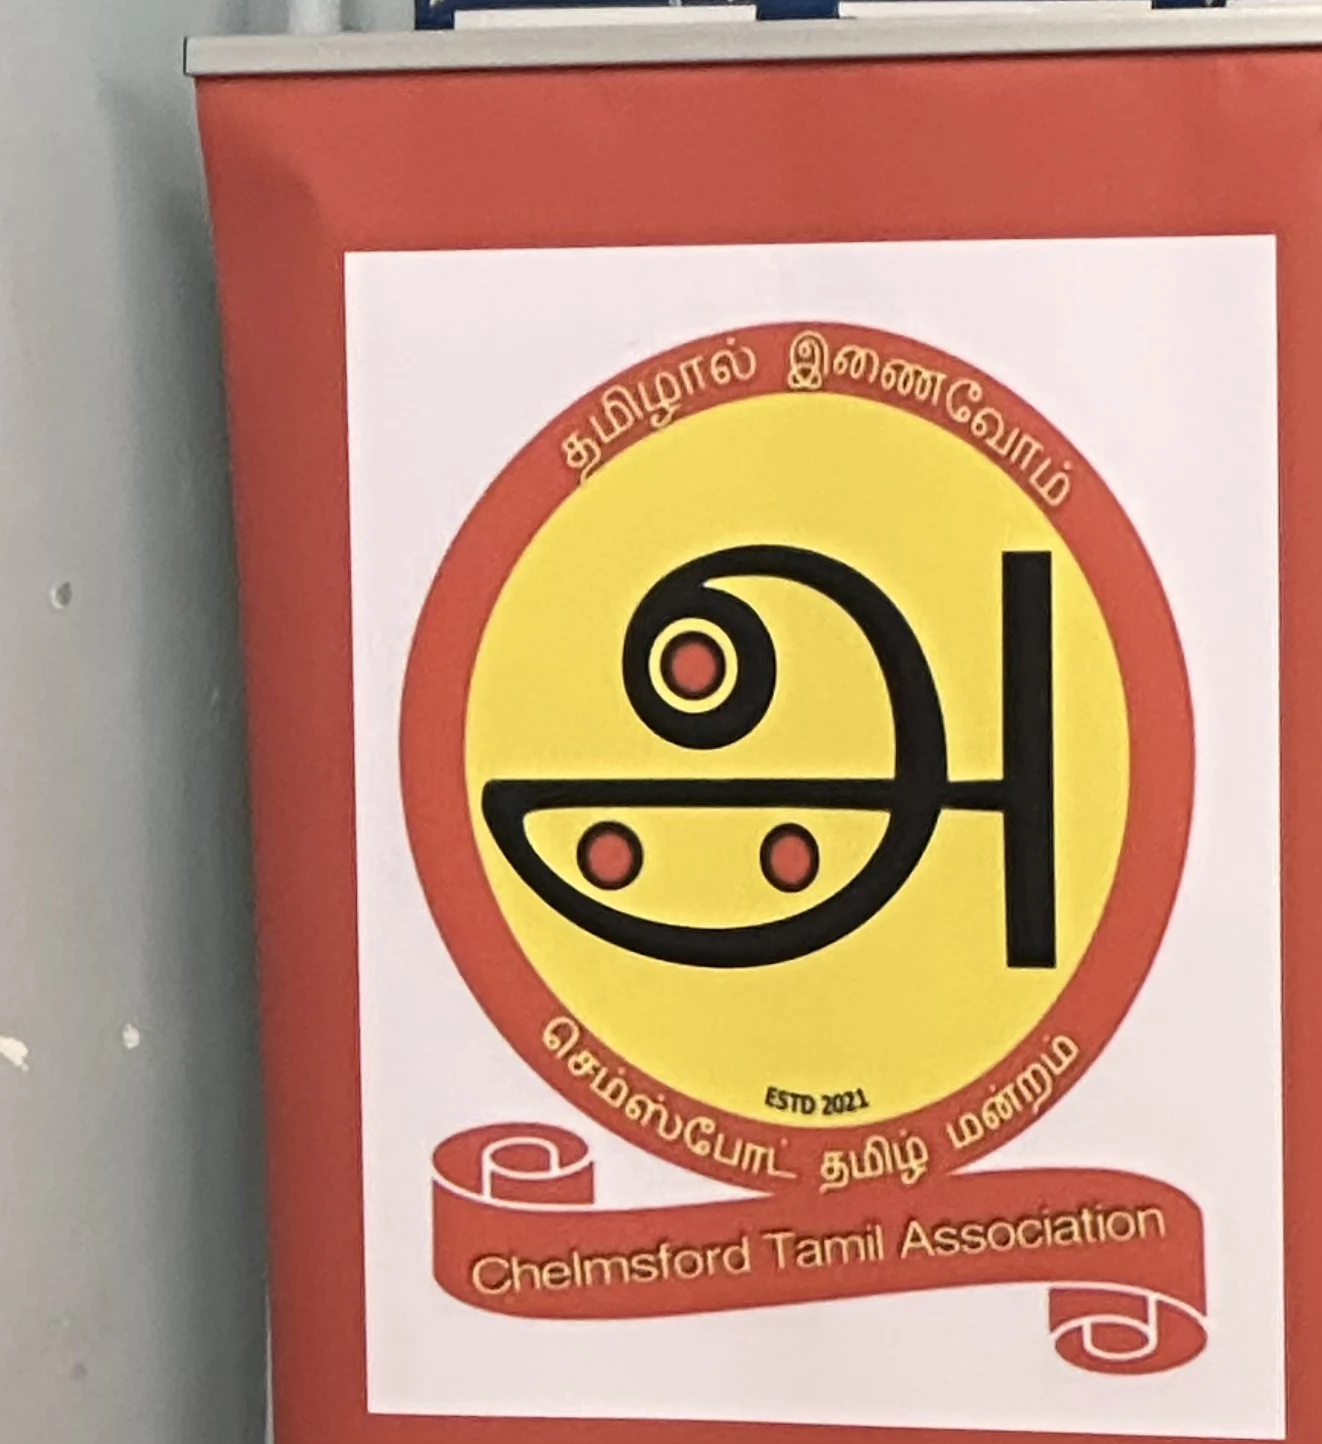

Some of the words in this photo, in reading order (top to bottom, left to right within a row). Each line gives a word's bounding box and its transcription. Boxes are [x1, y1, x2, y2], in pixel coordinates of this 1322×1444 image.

[562, 336, 757, 487] தமிழால்
[787, 329, 1072, 507] இணைவோம்
[765, 1086, 816, 1115] ESTD
[822, 1088, 870, 1115] 2021
[820, 1130, 929, 1193] தமிழ்
[946, 1033, 1080, 1151] மன்றம்
[471, 1234, 752, 1296] Chelmsford
[763, 1225, 885, 1272] Tamil
[900, 1204, 1166, 1259] Association
